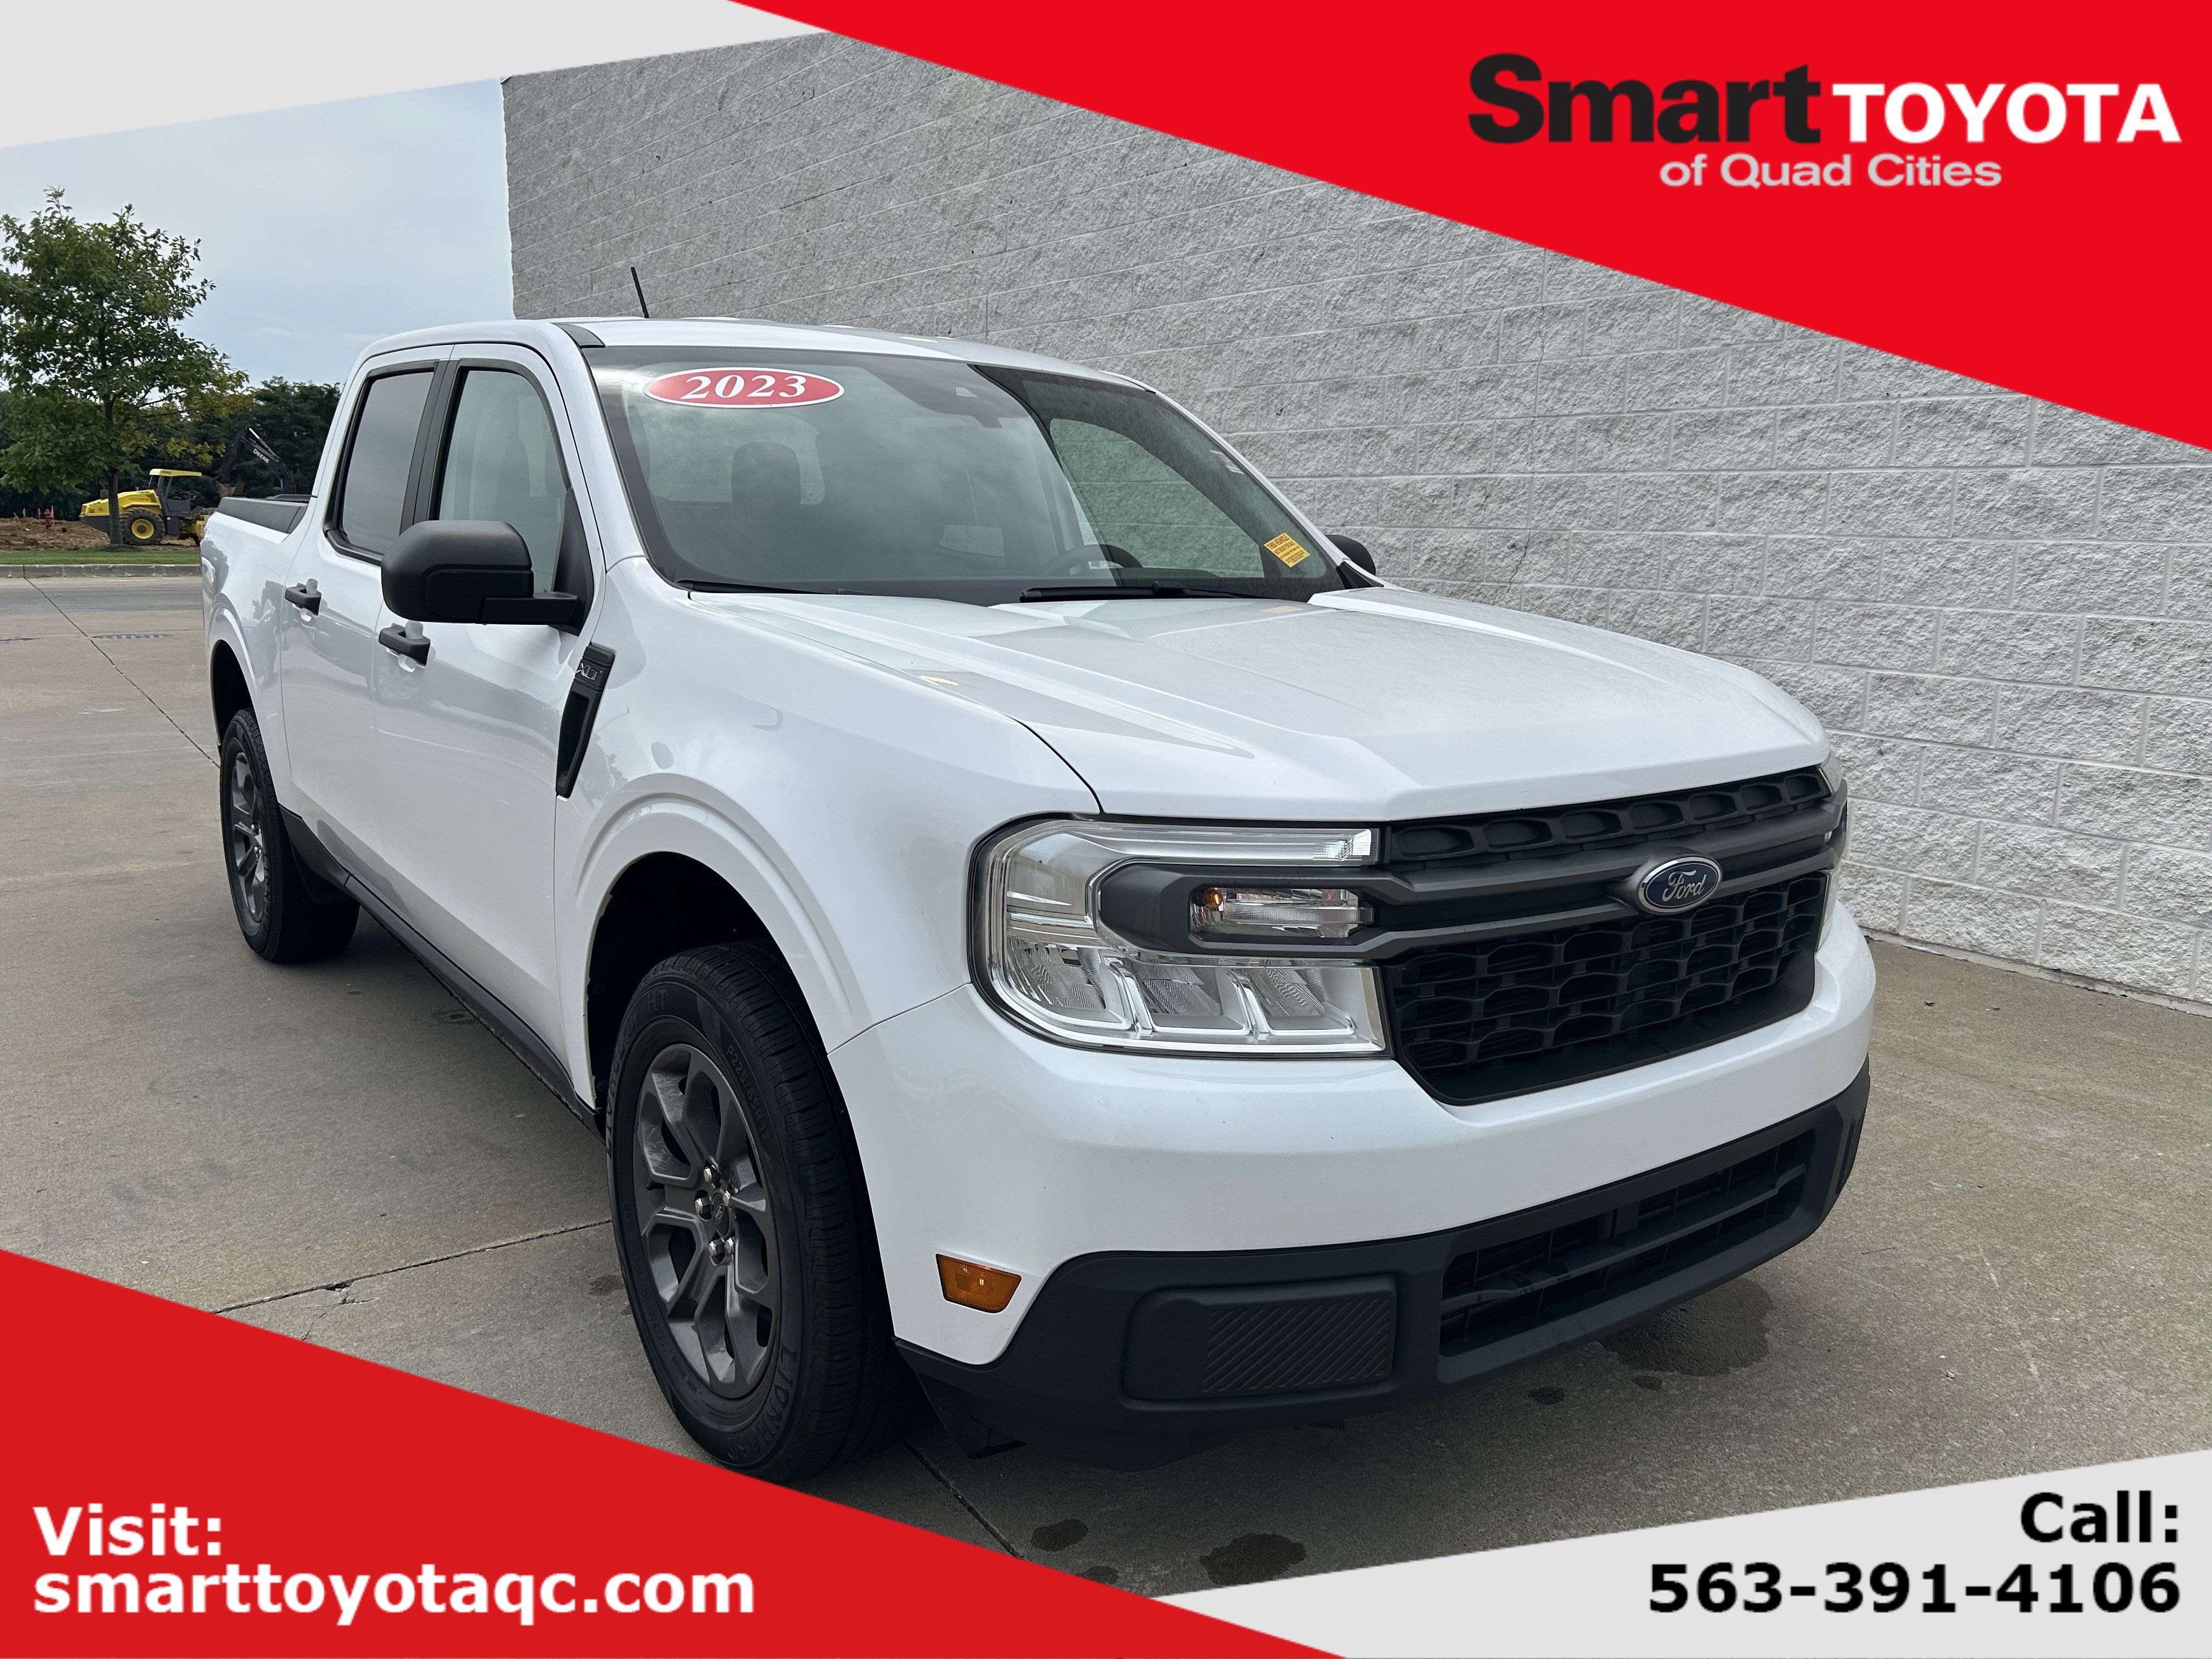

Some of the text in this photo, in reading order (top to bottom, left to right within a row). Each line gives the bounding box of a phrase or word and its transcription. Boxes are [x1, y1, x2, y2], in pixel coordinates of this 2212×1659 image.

[680, 375, 807, 399] 2023
[253, 448, 270, 464] DEERE
[576, 662, 603, 681] XLT
[1662, 870, 1707, 902] Ford
